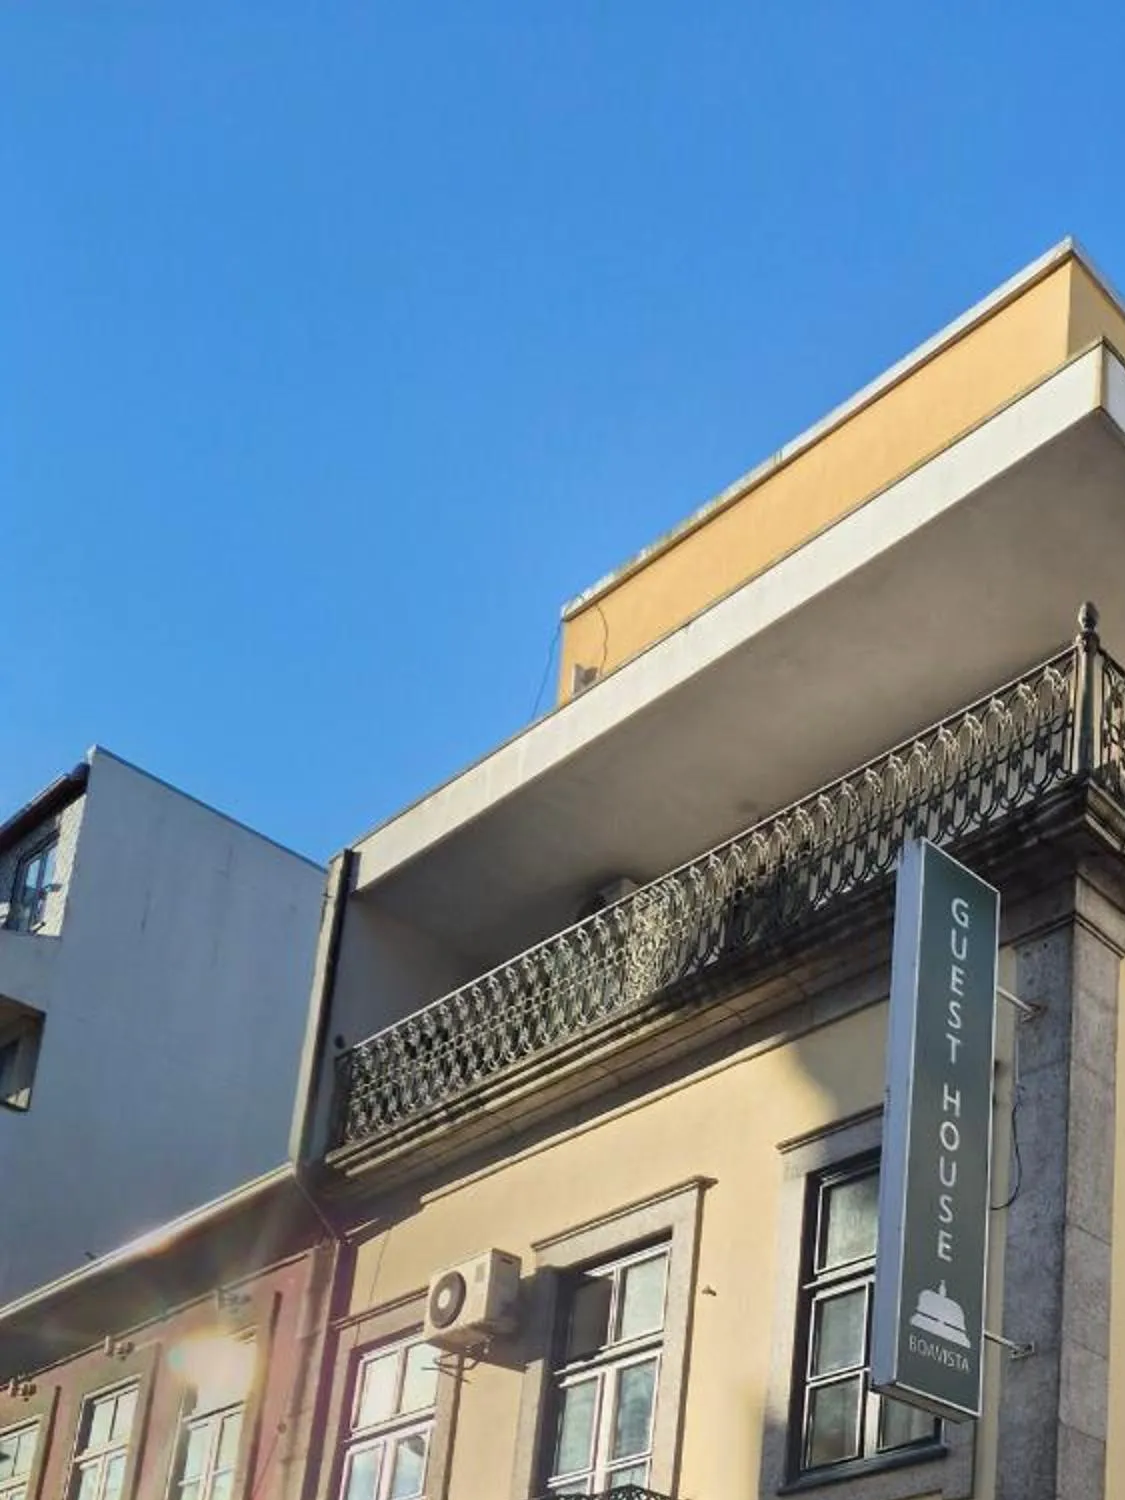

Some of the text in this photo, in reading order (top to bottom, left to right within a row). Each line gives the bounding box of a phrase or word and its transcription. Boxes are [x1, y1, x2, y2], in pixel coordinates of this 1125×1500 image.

[937, 897, 969, 1262] GUEST HOUSE
[909, 1333, 969, 1373] BOAVISTA
